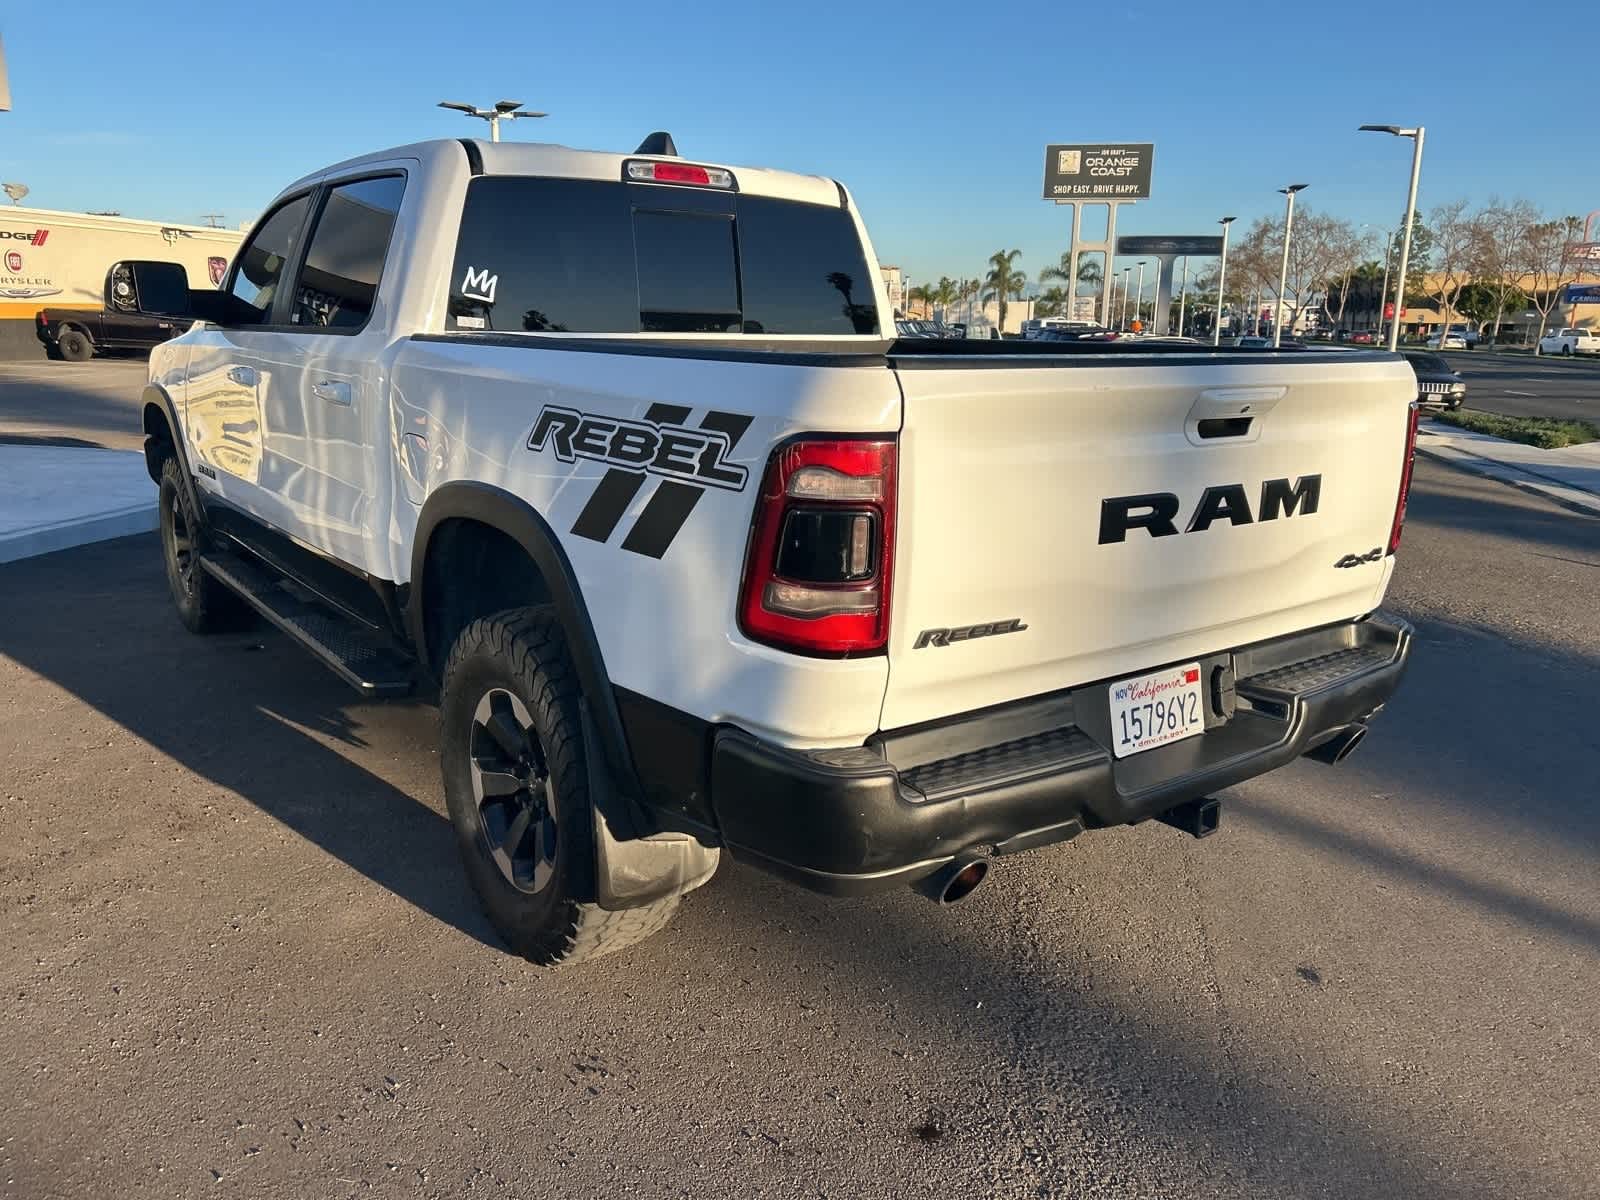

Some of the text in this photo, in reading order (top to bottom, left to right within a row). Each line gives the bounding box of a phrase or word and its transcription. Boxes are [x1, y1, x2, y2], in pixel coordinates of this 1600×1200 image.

[1085, 157, 1139, 167] ORANGE
[1090, 167, 1133, 176] COAST
[1053, 184, 1140, 194] SHOP EASY. DRIVE HAPPY.
[527, 404, 749, 492] REBEL
[1098, 473, 1322, 545] RAM
[912, 618, 1029, 649] REBEL
[1115, 687, 1129, 701] NOV
[1131, 679, 1186, 701] California
[1120, 691, 1199, 745] 15796Y2
[1138, 729, 1184, 748] dmv.ca.gov
